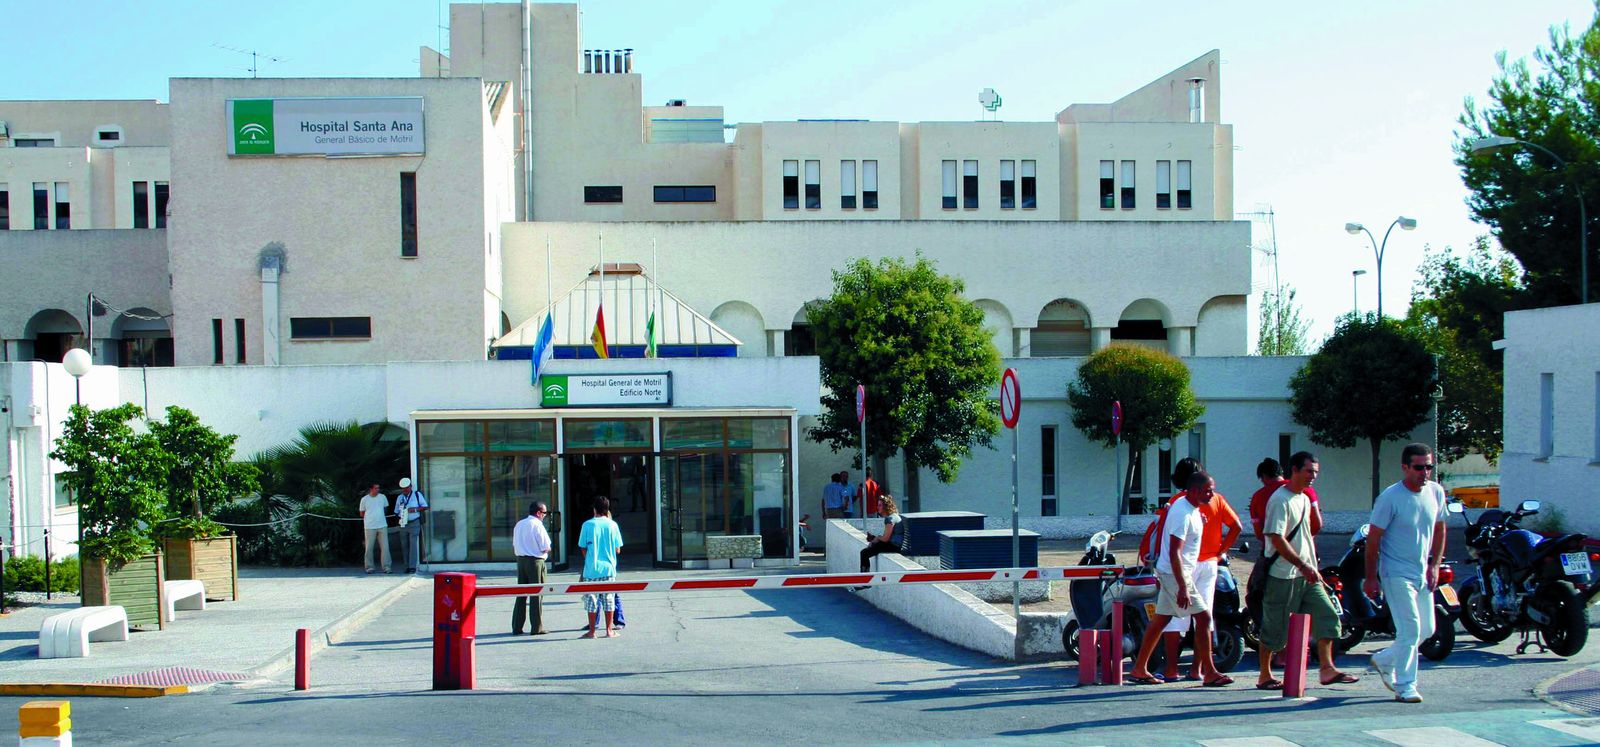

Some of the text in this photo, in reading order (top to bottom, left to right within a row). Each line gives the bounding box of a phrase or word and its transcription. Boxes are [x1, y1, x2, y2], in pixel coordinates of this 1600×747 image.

[300, 121, 413, 134] Hospital Santa Ana
[315, 135, 413, 144] General Básico de Motril
[581, 379, 607, 388] Hospital
[608, 379, 632, 387] General
[643, 378, 662, 386] Motril
[619, 388, 662, 397] Edificio Norte
